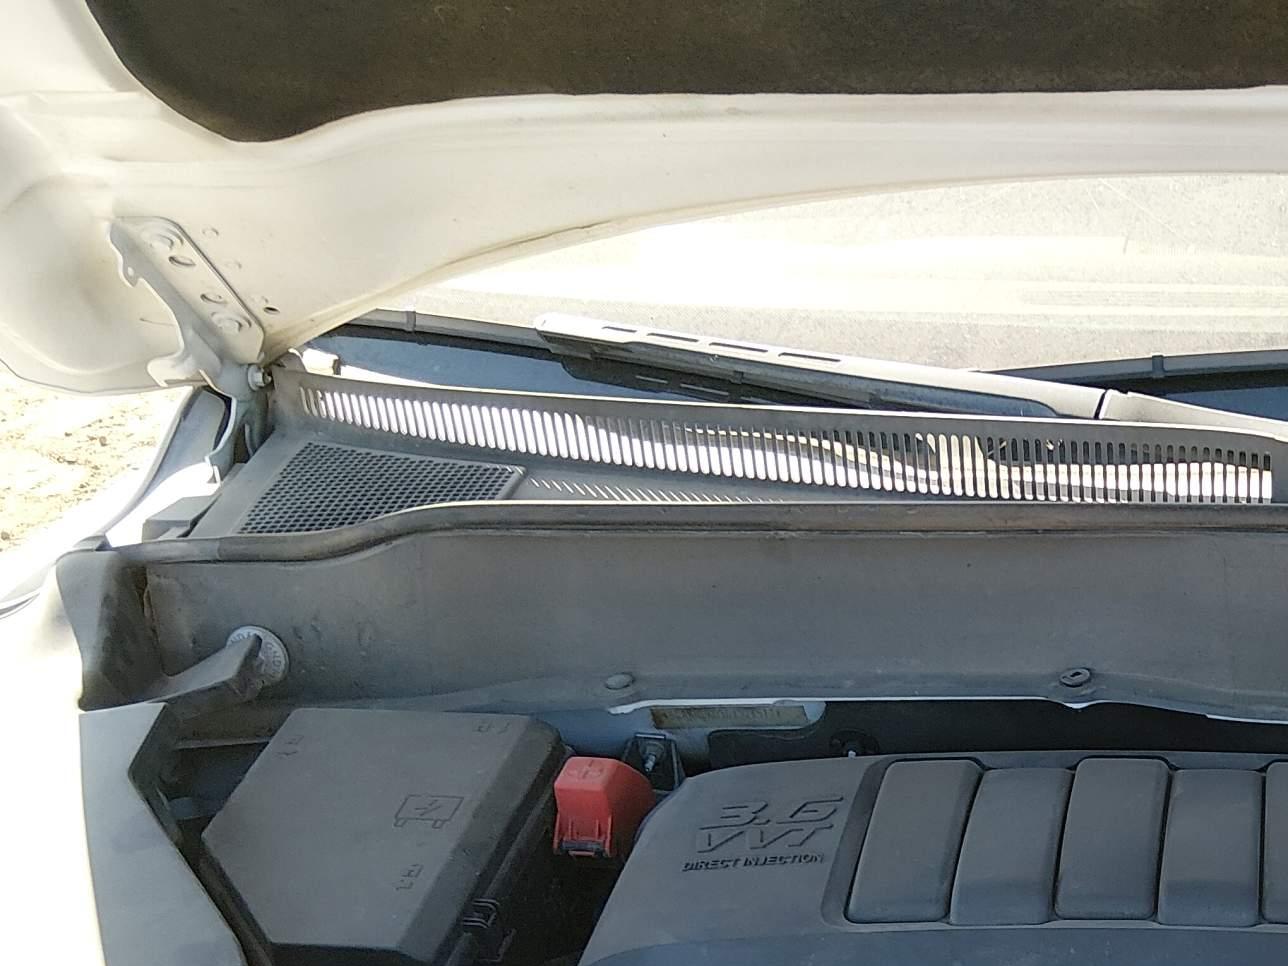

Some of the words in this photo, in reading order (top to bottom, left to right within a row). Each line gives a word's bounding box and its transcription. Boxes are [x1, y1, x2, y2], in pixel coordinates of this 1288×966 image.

[699, 797, 844, 830] 3.6
[697, 823, 834, 854] VVT
[681, 858, 741, 872] DIRECT
[743, 853, 825, 867] INJECTION
